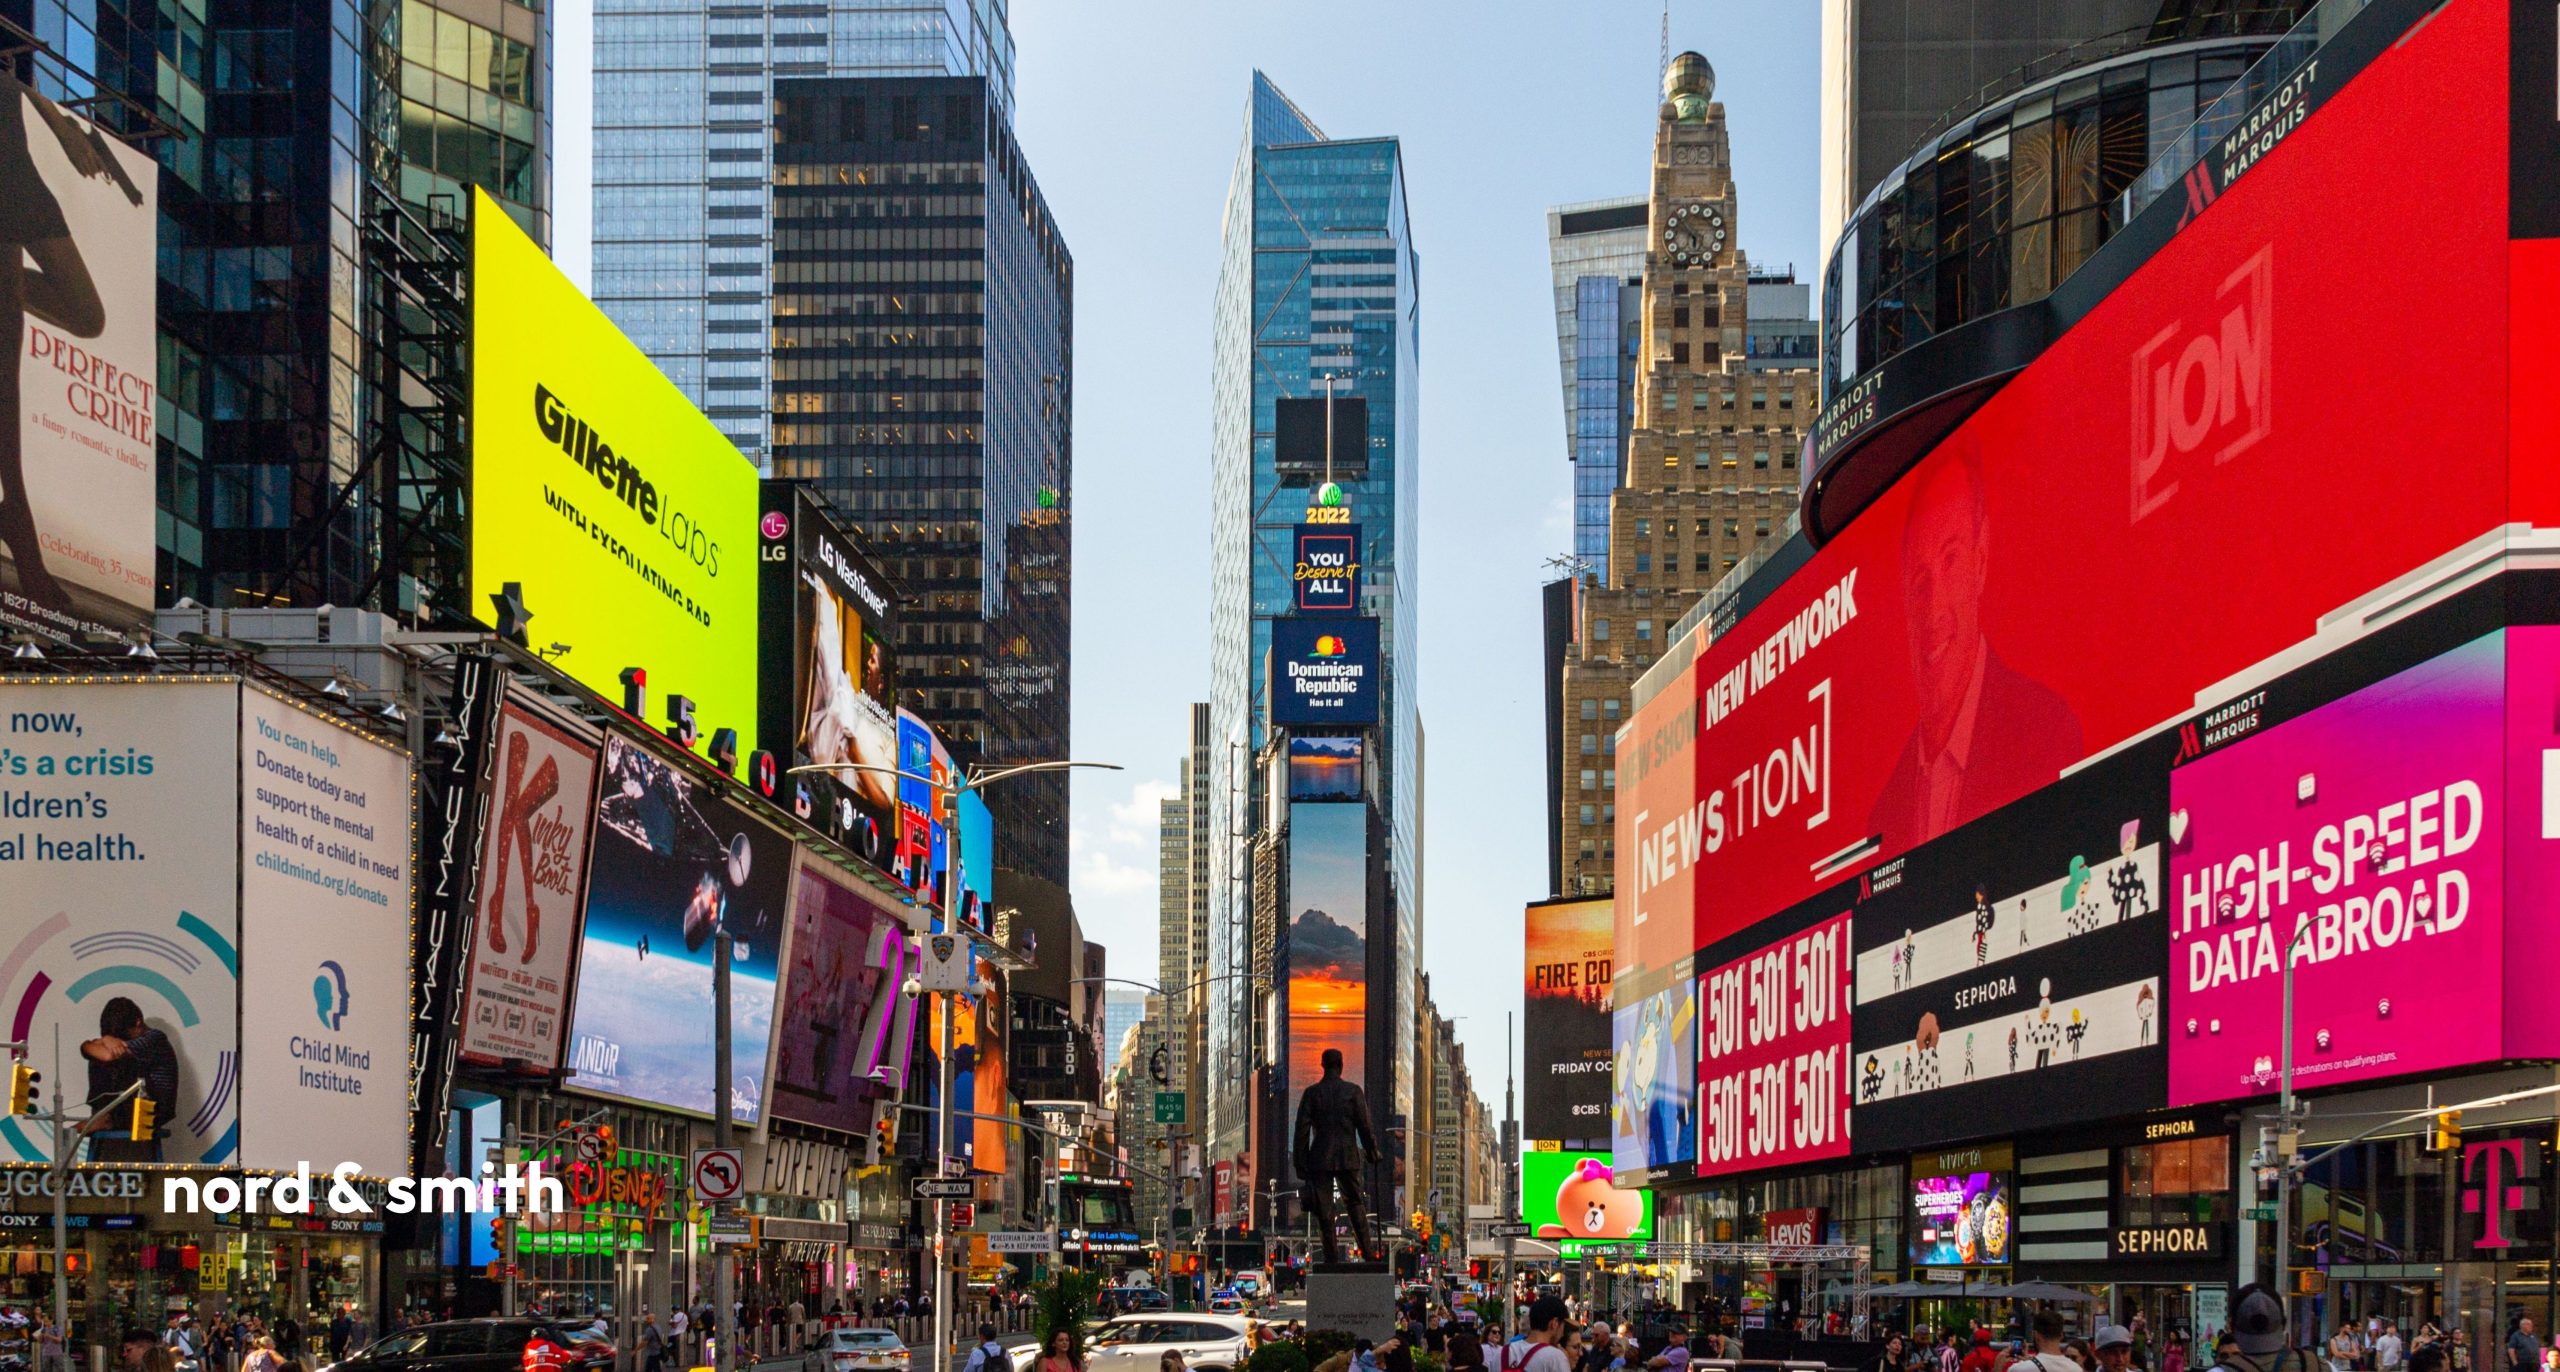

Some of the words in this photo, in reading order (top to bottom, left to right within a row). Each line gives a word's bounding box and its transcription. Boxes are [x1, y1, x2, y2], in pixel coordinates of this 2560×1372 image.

[2224, 60, 2318, 159] MARRIOTT
[2224, 101, 2305, 187] MARQUIS
[30, 325, 154, 412] PERFECT
[67, 382, 152, 448] CRIME
[1818, 371, 1884, 436] MARRIOTT
[32, 414, 38, 424] a
[42, 412, 68, 439] funny
[72, 430, 113, 456] romantic
[117, 447, 148, 472] thriller
[1818, 402, 1873, 459] MARQUIS
[1306, 508, 1350, 524] 2022
[40, 532, 106, 576] Celebrating
[110, 559, 122, 576] 35
[762, 546, 786, 562] LG
[820, 534, 834, 568] LG
[1309, 552, 1344, 567] YOU
[1294, 562, 1346, 581] Deserve
[1346, 562, 1360, 581] it
[1309, 580, 1344, 594] ALL
[4, 591, 28, 610] 1627
[30, 601, 80, 630] Broadway
[80, 621, 90, 633] at
[1706, 658, 1748, 730] NEW
[1750, 567, 1858, 696] NETWORK
[1288, 660, 1363, 678] Dominican
[1295, 677, 1357, 697] Republic
[1309, 698, 1324, 708] Has
[1326, 698, 1333, 708] it
[1334, 698, 1344, 708] all
[2205, 691, 2266, 730] MARRIOTT
[12, 712, 82, 738] now,
[2205, 714, 2258, 747] MARQUIS
[256, 716, 280, 742] You
[284, 733, 308, 754] can
[312, 740, 340, 768] help.
[36, 756, 54, 776] a
[65, 748, 154, 776] crisis
[1620, 737, 1651, 797] NEW
[256, 750, 304, 784] Donate
[306, 772, 341, 802] today
[344, 792, 366, 808] and
[256, 787, 308, 817] support
[310, 804, 330, 826] the
[334, 815, 374, 842] mental
[37, 834, 145, 860] health.
[256, 816, 298, 846] health
[302, 834, 314, 850] of
[317, 840, 324, 855] a
[327, 844, 356, 866] child
[360, 852, 370, 871] in
[372, 860, 399, 880] need
[2182, 779, 2483, 933] HIGH-SPEED
[256, 851, 388, 907] childmind.org/donate
[533, 854, 574, 896] Boots
[1872, 858, 1905, 880] MARRIOTT
[1872, 873, 1902, 894] MARQUIS
[2189, 922, 2280, 993] DATA
[2289, 869, 2470, 968] ABROAD
[1536, 962, 1578, 989] FIRE
[1954, 976, 2017, 1010] SEPHORA
[290, 1036, 331, 1064] Child
[336, 1044, 370, 1070] Mind
[576, 1036, 620, 1078] ANDOR
[1065, 1031, 1074, 1075] 1500
[1552, 1062, 1592, 1074] FRIDAY
[1584, 1050, 1602, 1058] NEW
[300, 1066, 362, 1096] Institute
[2240, 1074, 2249, 1084] Up
[2296, 1063, 2332, 1076] destinations
[2333, 1062, 2342, 1070] on
[2343, 1054, 2376, 1070] qualifying
[1581, 1104, 1600, 1115] CBS
[2146, 1120, 2195, 1138] SEPHORA
[762, 1135, 848, 1201] FOREVER
[1940, 1148, 1982, 1170] INVICTA
[921, 1184, 939, 1194] ONE
[946, 1184, 968, 1192] WAY
[1915, 1191, 1964, 1207] SUPERHEROES
[331, 1220, 360, 1232] SONY
[1494, 1228, 1511, 1236] ONE
[2118, 1228, 2208, 1254] SEPHORA
[786, 1241, 822, 1262] FOREVER
[203, 1255, 214, 1286] ATM
[218, 1254, 226, 1286] ATM
